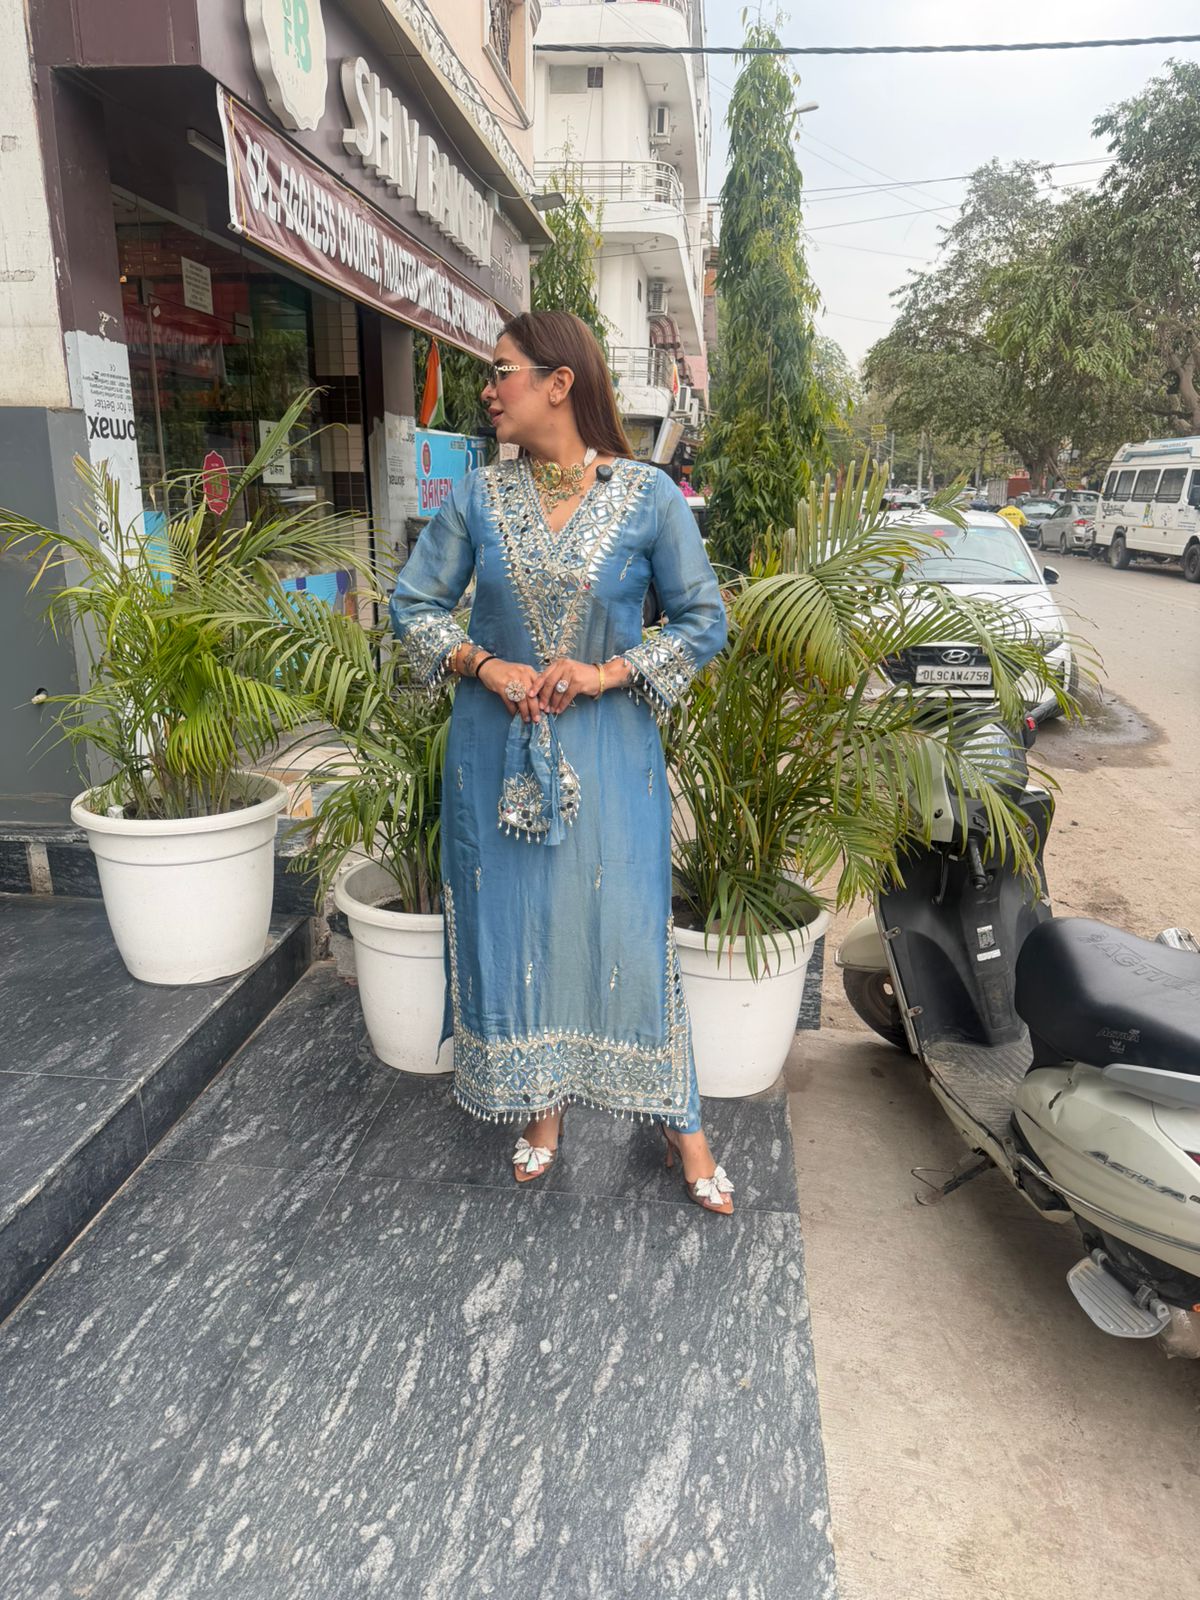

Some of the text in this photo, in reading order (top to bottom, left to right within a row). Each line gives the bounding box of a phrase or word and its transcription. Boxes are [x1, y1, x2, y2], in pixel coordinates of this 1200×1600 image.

[280, 161, 337, 258] EGGLESS
[342, 57, 494, 268] SHIV BAKERY
